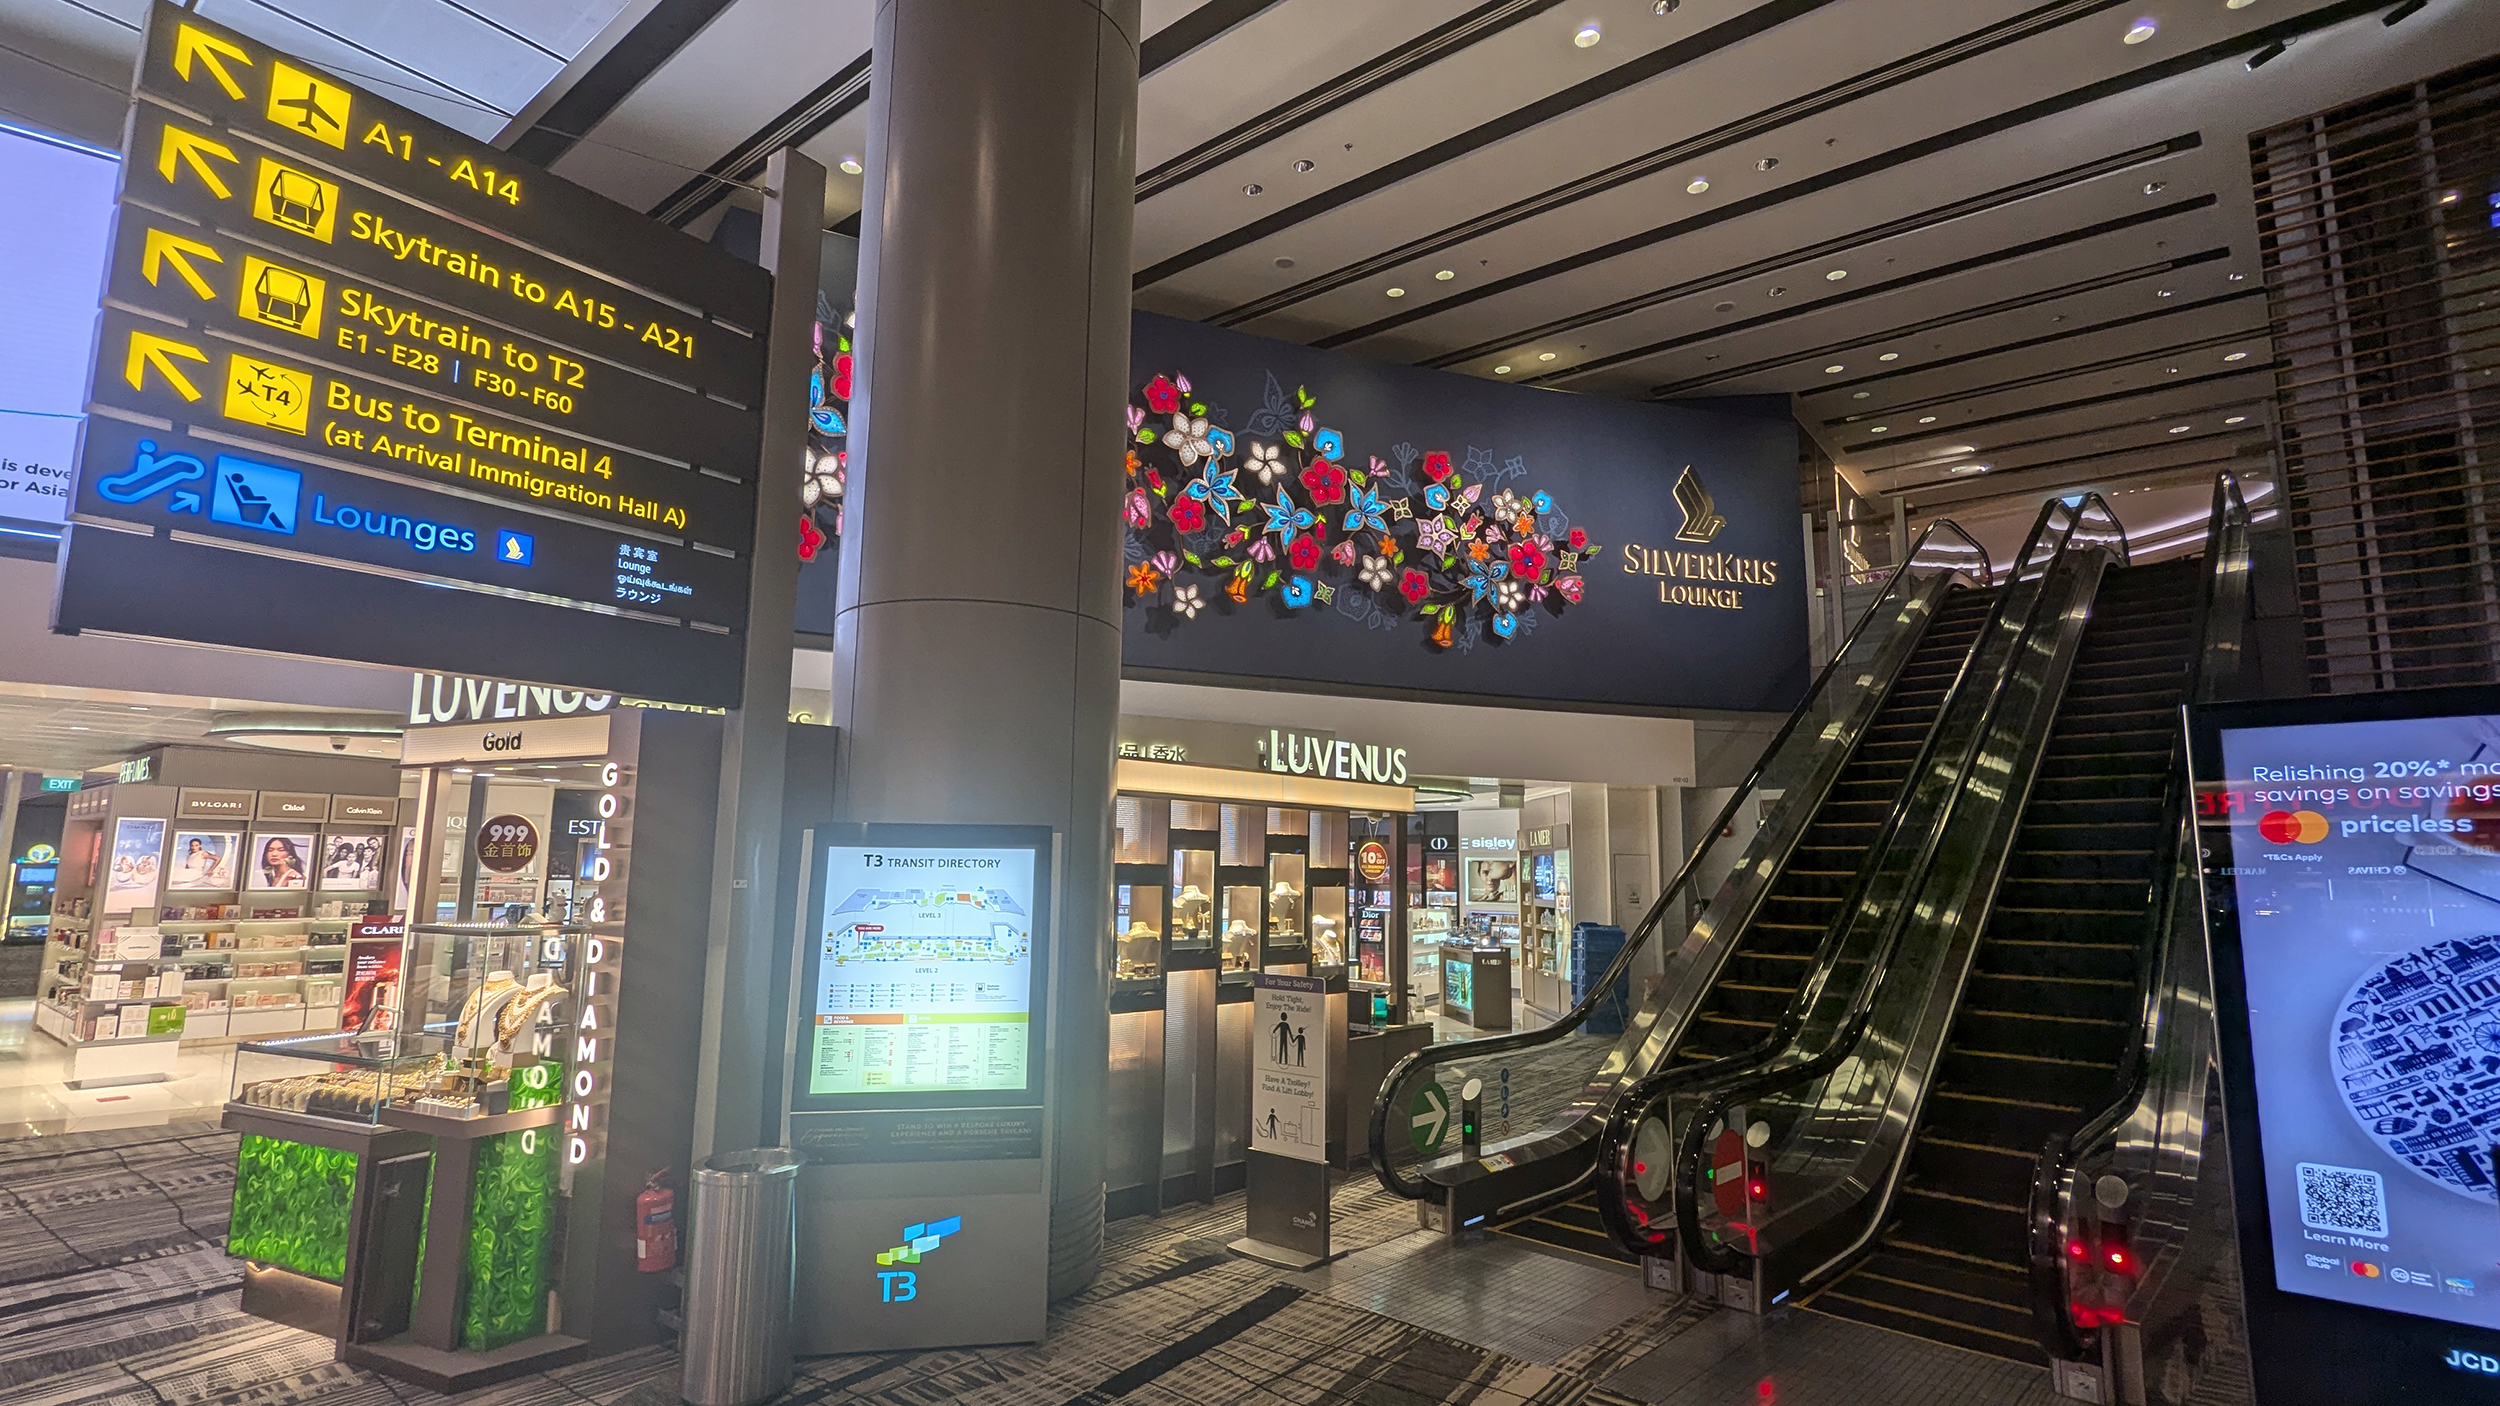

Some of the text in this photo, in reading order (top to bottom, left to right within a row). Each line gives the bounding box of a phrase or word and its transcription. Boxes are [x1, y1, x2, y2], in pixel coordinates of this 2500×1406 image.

[363, 122, 521, 206] A1 - A14
[350, 211, 694, 359] Skytrain to A15 - A21
[340, 288, 586, 390] Skytrain to T2
[337, 327, 367, 354] E1
[391, 344, 440, 375] E28
[474, 369, 517, 397] F30
[533, 387, 573, 415] F60
[262, 384, 290, 406] T4
[327, 381, 613, 480] Bus to Terminal 4
[1, 458, 72, 480] is deve
[324, 421, 687, 530] (at Arrival Immigration Hall A)
[24, 481, 68, 498] Asia
[314, 495, 476, 551] Lounges
[619, 543, 659, 563] 贵宾室
[617, 557, 652, 575] Lounge
[615, 586, 661, 604] ラウンジ
[1659, 580, 1743, 610] LOUNGE
[410, 672, 612, 724] LUVEN
[482, 731, 522, 752] Gold
[1270, 729, 1407, 785] LUVENUS
[119, 756, 151, 784] PERFUMES
[2252, 764, 2365, 784] Relishing
[2460, 762, 2500, 776] mo
[49, 779, 74, 790] EXIT
[2254, 782, 2500, 804] savings on savings
[191, 800, 242, 809] BVLGARI
[282, 803, 305, 812] Chloé
[568, 819, 605, 835] EST
[592, 762, 618, 883] GOLD
[2340, 814, 2474, 838] priceless
[490, 824, 529, 842] 999
[1529, 829, 1551, 847] LA MER
[482, 842, 533, 858] 金首饰
[1471, 837, 1516, 850] sisley
[863, 854, 1001, 868] T3 TRANSIT DIRECTORY
[2295, 852, 2323, 862] Apply
[1361, 910, 1379, 919] Dior
[361, 926, 404, 935] CLARI
[1264, 978, 1314, 990] For Your Safety
[1265, 1002, 1312, 1013] Enjoy The Ride!
[1271, 994, 1285, 1002] Hold
[569, 938, 604, 1165] DIAMOND
[1262, 1083, 1275, 1092] Find
[1282, 1086, 1293, 1095] Lift
[1294, 1088, 1315, 1099] Lobby!
[1264, 1075, 1280, 1083] Have
[1287, 1078, 1310, 1088] Trolley?
[2303, 1229, 2390, 1252] Learn More
[2304, 1253, 2340, 1266] Global
[2306, 1259, 2331, 1270] Blue
[877, 1270, 917, 1303] T3
[2445, 1349, 2500, 1374] JCD
